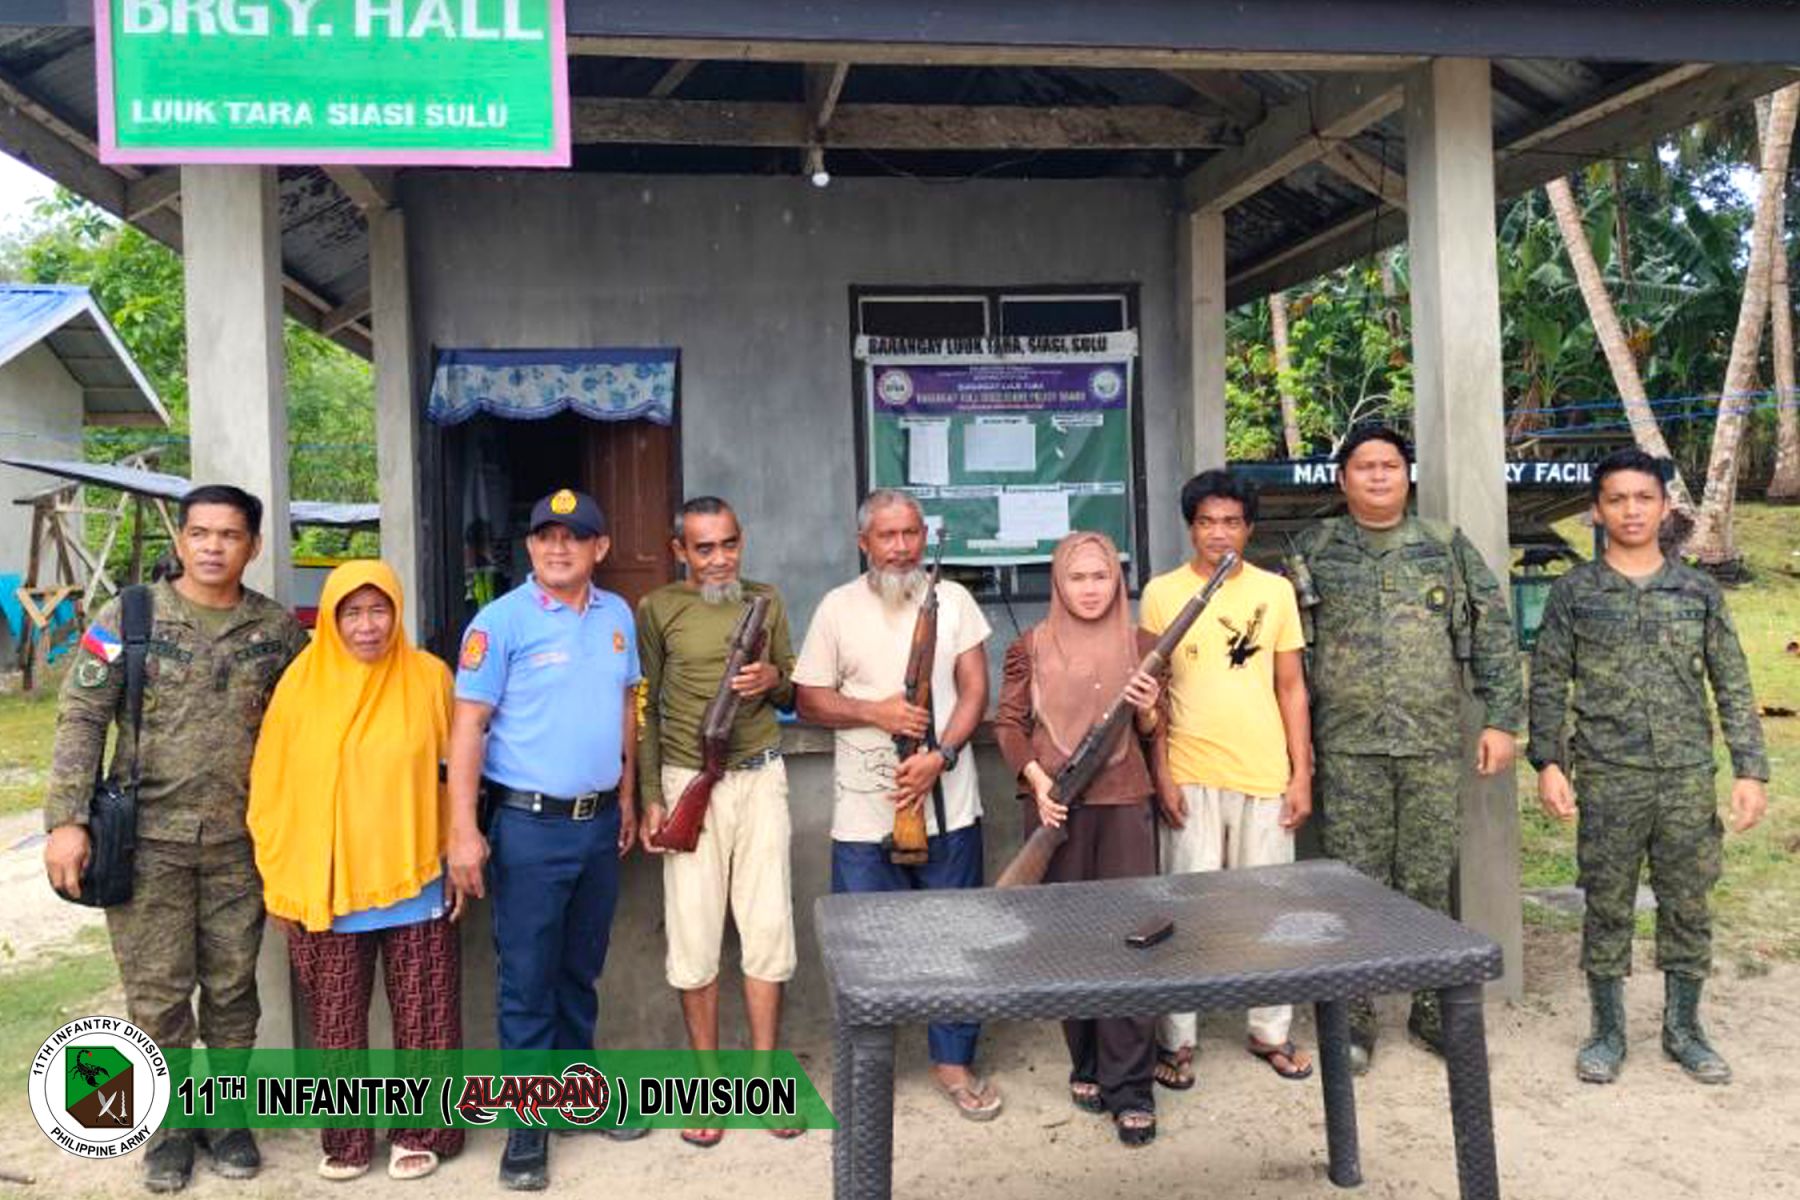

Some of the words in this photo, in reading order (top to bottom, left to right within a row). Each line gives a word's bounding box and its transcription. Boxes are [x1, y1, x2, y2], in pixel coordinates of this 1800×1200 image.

[122, 0, 333, 37] BRGY.
[354, 0, 544, 41] HALL
[132, 99, 217, 124] LUUK
[223, 101, 313, 126] TARA
[327, 102, 414, 127] SIASI
[425, 103, 508, 128] SULU
